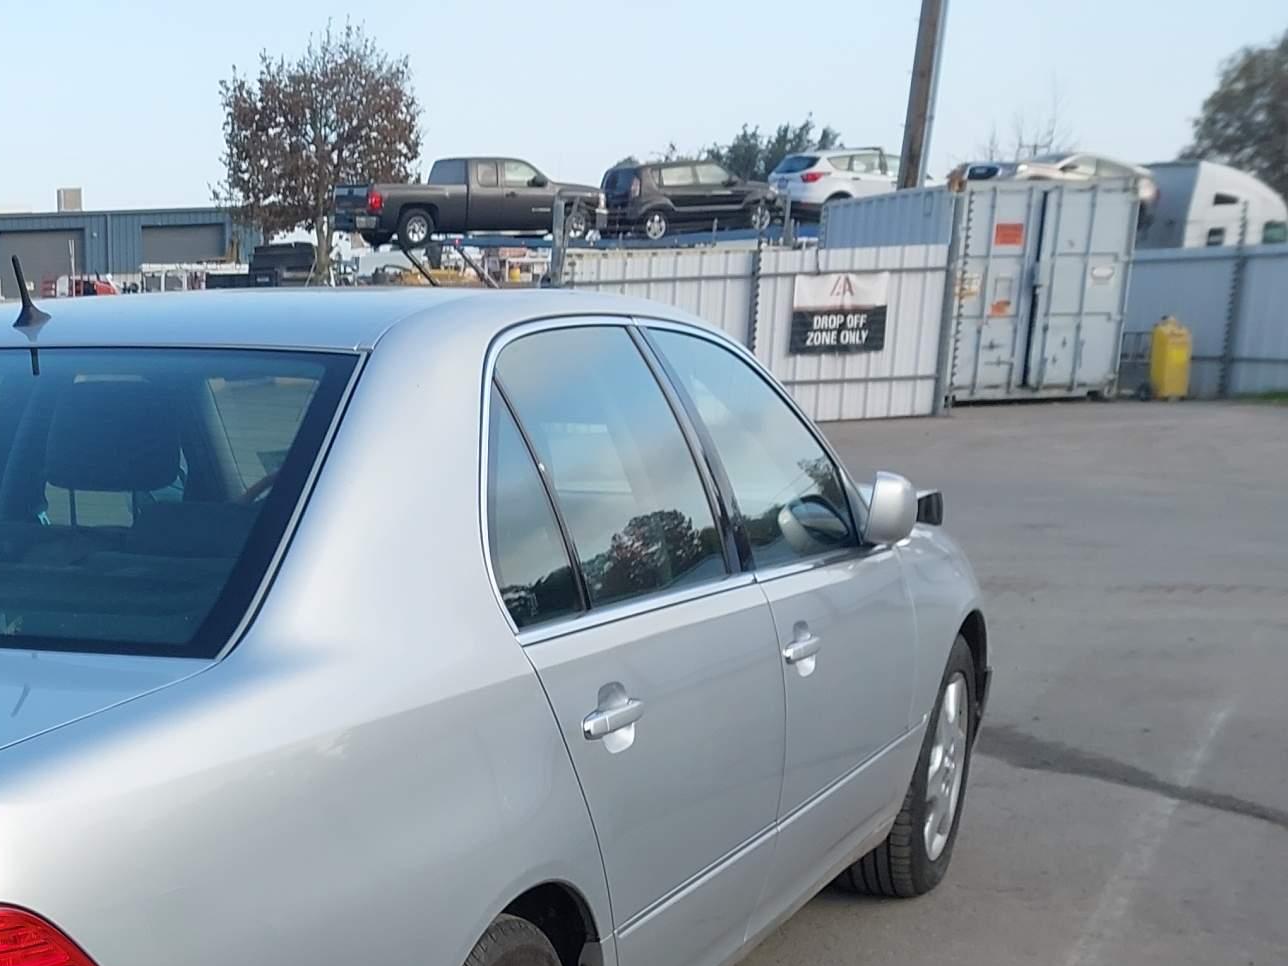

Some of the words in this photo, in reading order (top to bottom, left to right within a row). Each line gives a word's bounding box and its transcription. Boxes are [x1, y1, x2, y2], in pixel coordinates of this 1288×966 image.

[813, 315, 845, 330] DROP
[846, 314, 867, 329] OFF
[805, 331, 838, 346] ZONE
[839, 330, 869, 345] ONLY
